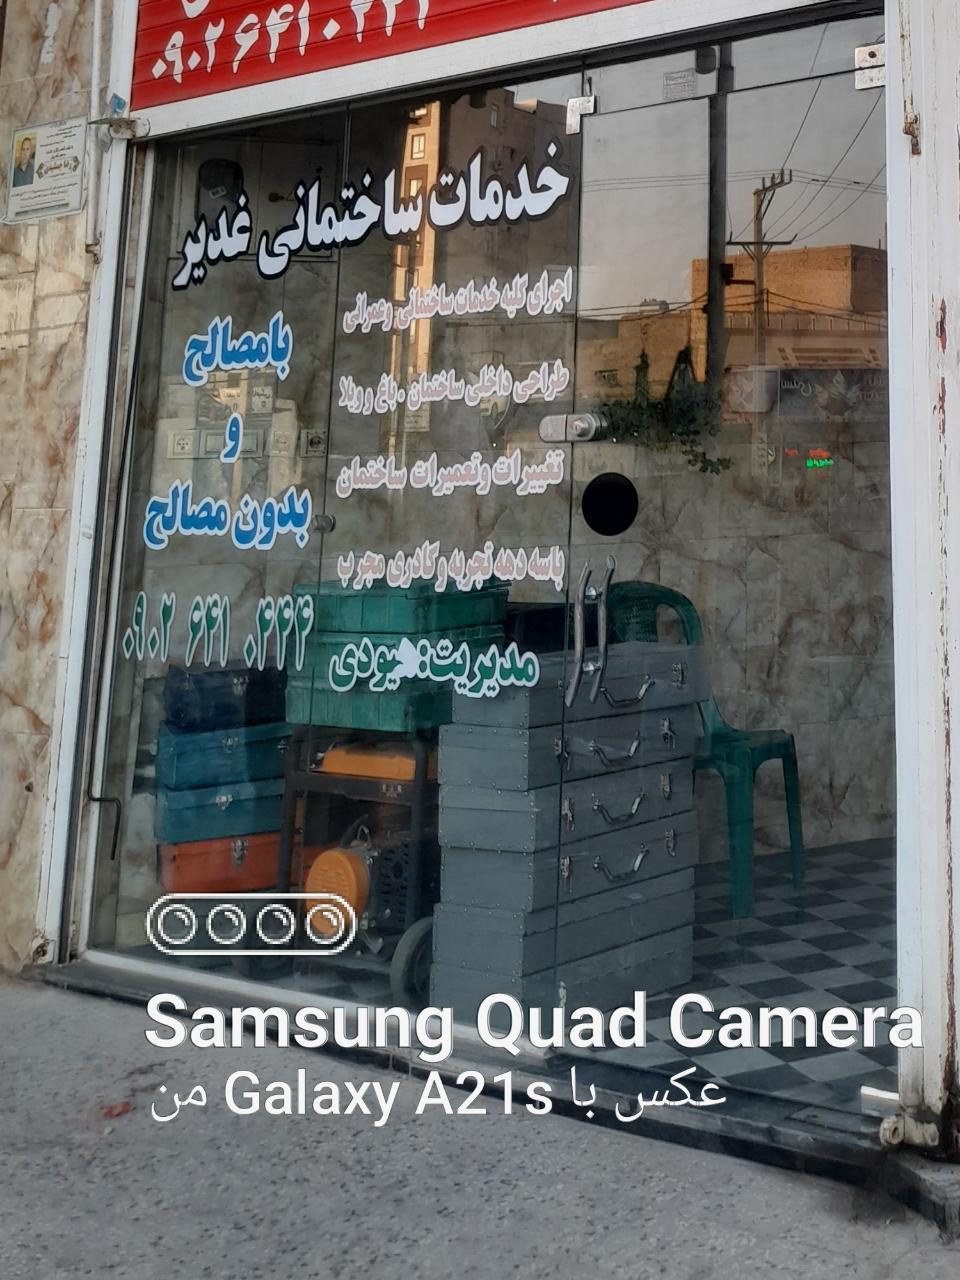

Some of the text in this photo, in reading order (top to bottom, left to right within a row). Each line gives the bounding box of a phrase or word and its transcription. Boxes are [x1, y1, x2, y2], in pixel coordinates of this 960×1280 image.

[172, 140, 571, 290] خدمات ساختمانی غدیر
[397, 282, 454, 329] ساختمانی
[454, 277, 500, 315] خدمات
[527, 266, 573, 315] اجرای
[464, 363, 513, 406] داخلی
[512, 359, 570, 403] طراحی
[220, 412, 243, 463] و
[336, 455, 408, 499] ساختمان
[491, 448, 565, 496] تغییرات
[144, 479, 312, 550] بدون مصالح
[337, 551, 385, 590] مجرب
[448, 541, 494, 592] تجربه
[122, 591, 314, 671] ۰۹۰۲ ۶۴۱ ۰۴۴۴
